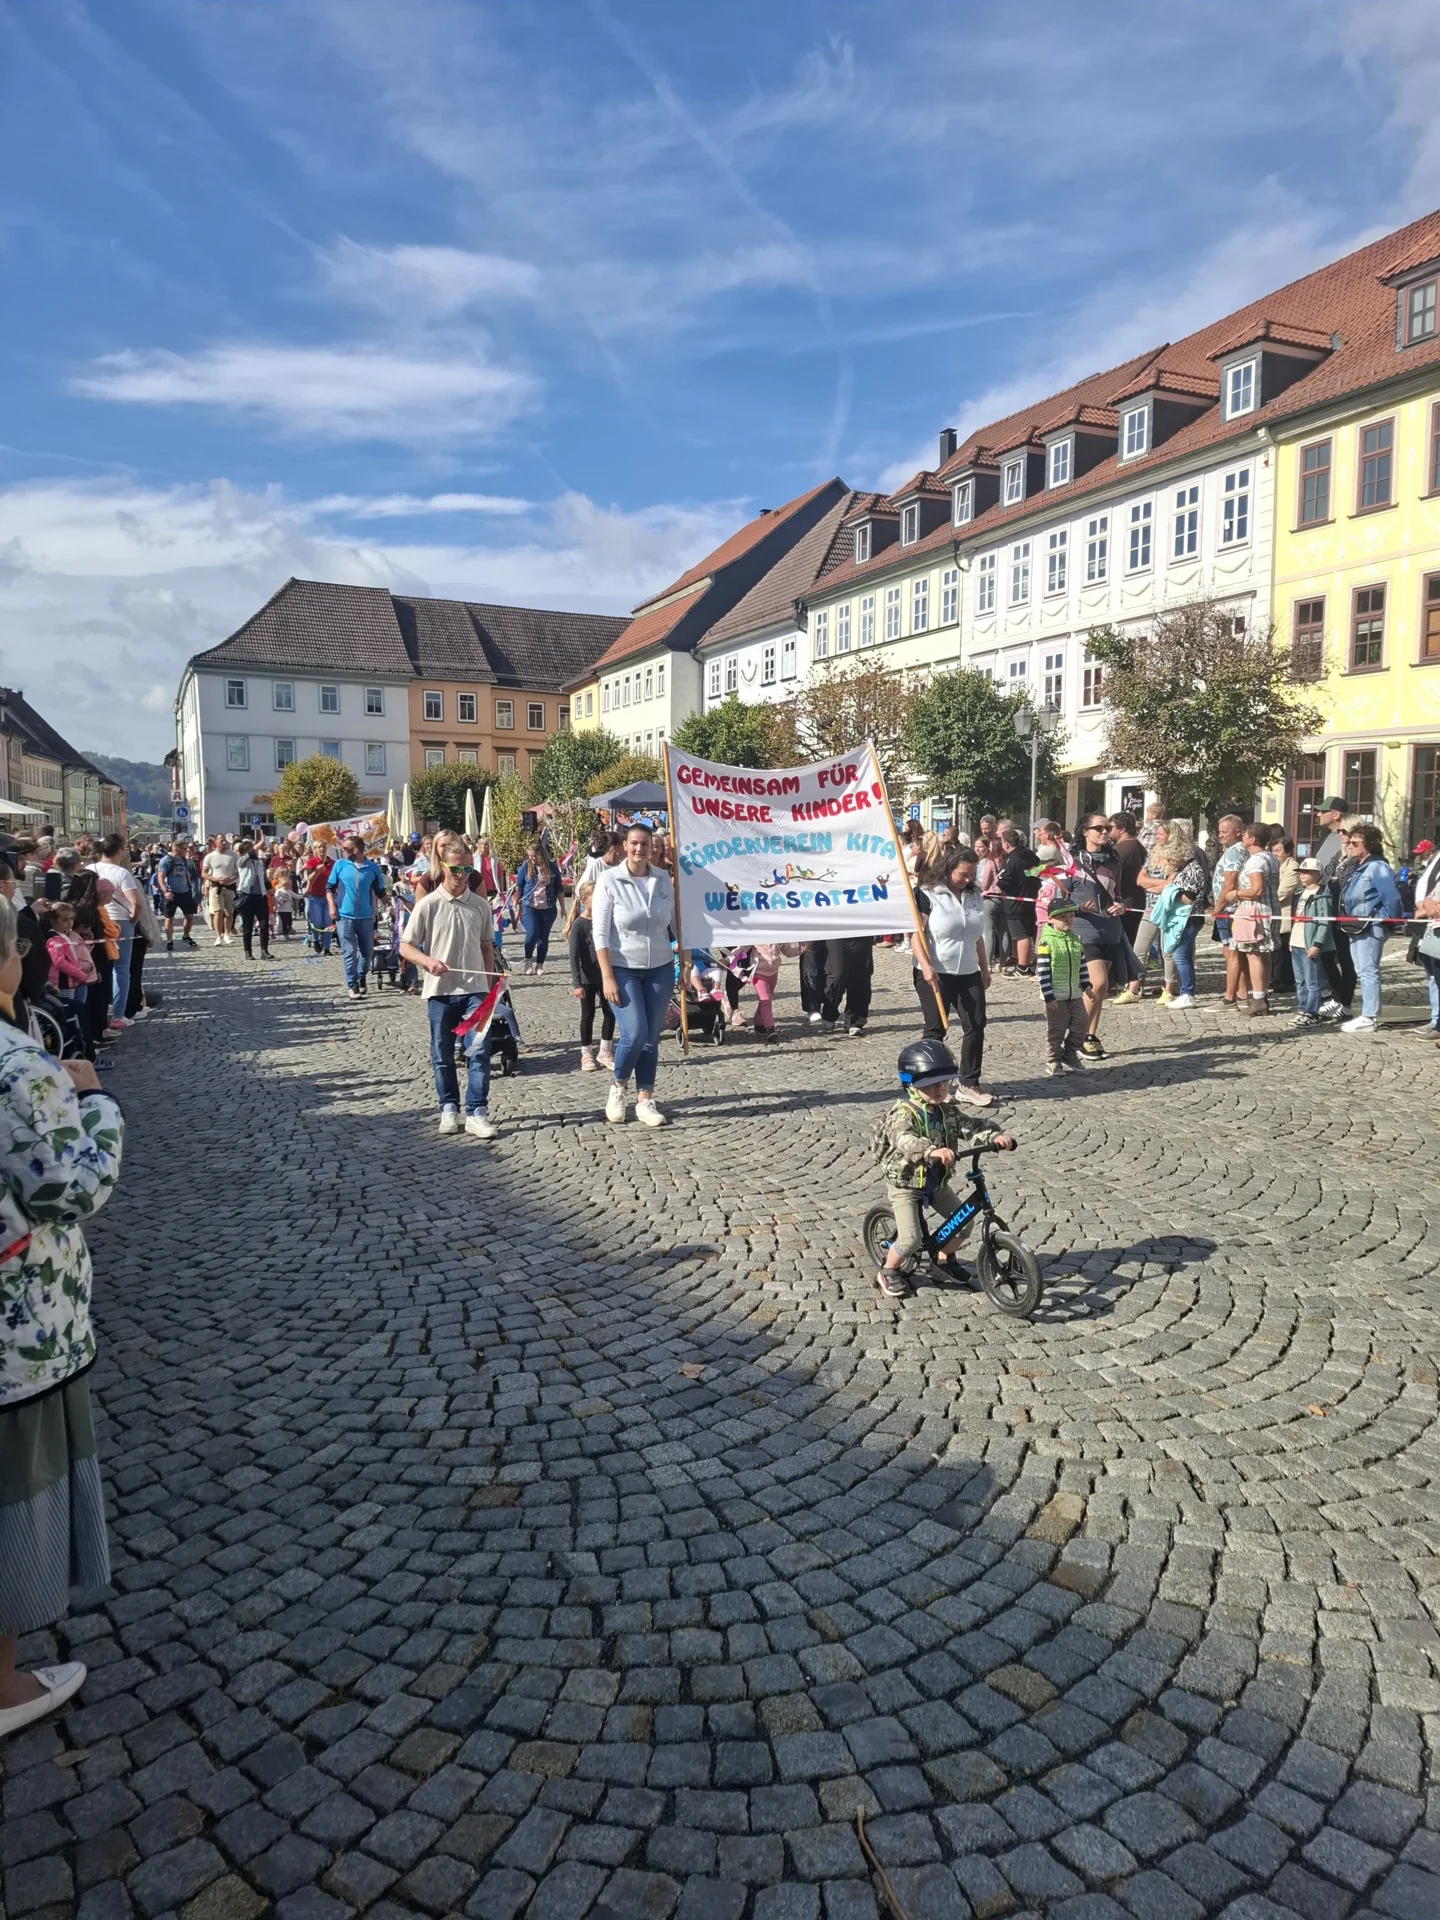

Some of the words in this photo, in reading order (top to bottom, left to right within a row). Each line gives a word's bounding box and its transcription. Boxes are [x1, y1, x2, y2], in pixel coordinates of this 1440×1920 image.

[677, 764, 800, 796] GEMEINSAM
[817, 763, 858, 788] FÜR
[691, 796, 773, 823] UNSERE
[791, 781, 884, 822] KINDER!
[912, 807, 919, 819] P
[679, 832, 832, 876] FÖRDERVEREIN
[846, 832, 897, 860] KITA
[704, 883, 888, 911] WERRASPATZEN
[935, 1202, 975, 1243] KIDWELL
